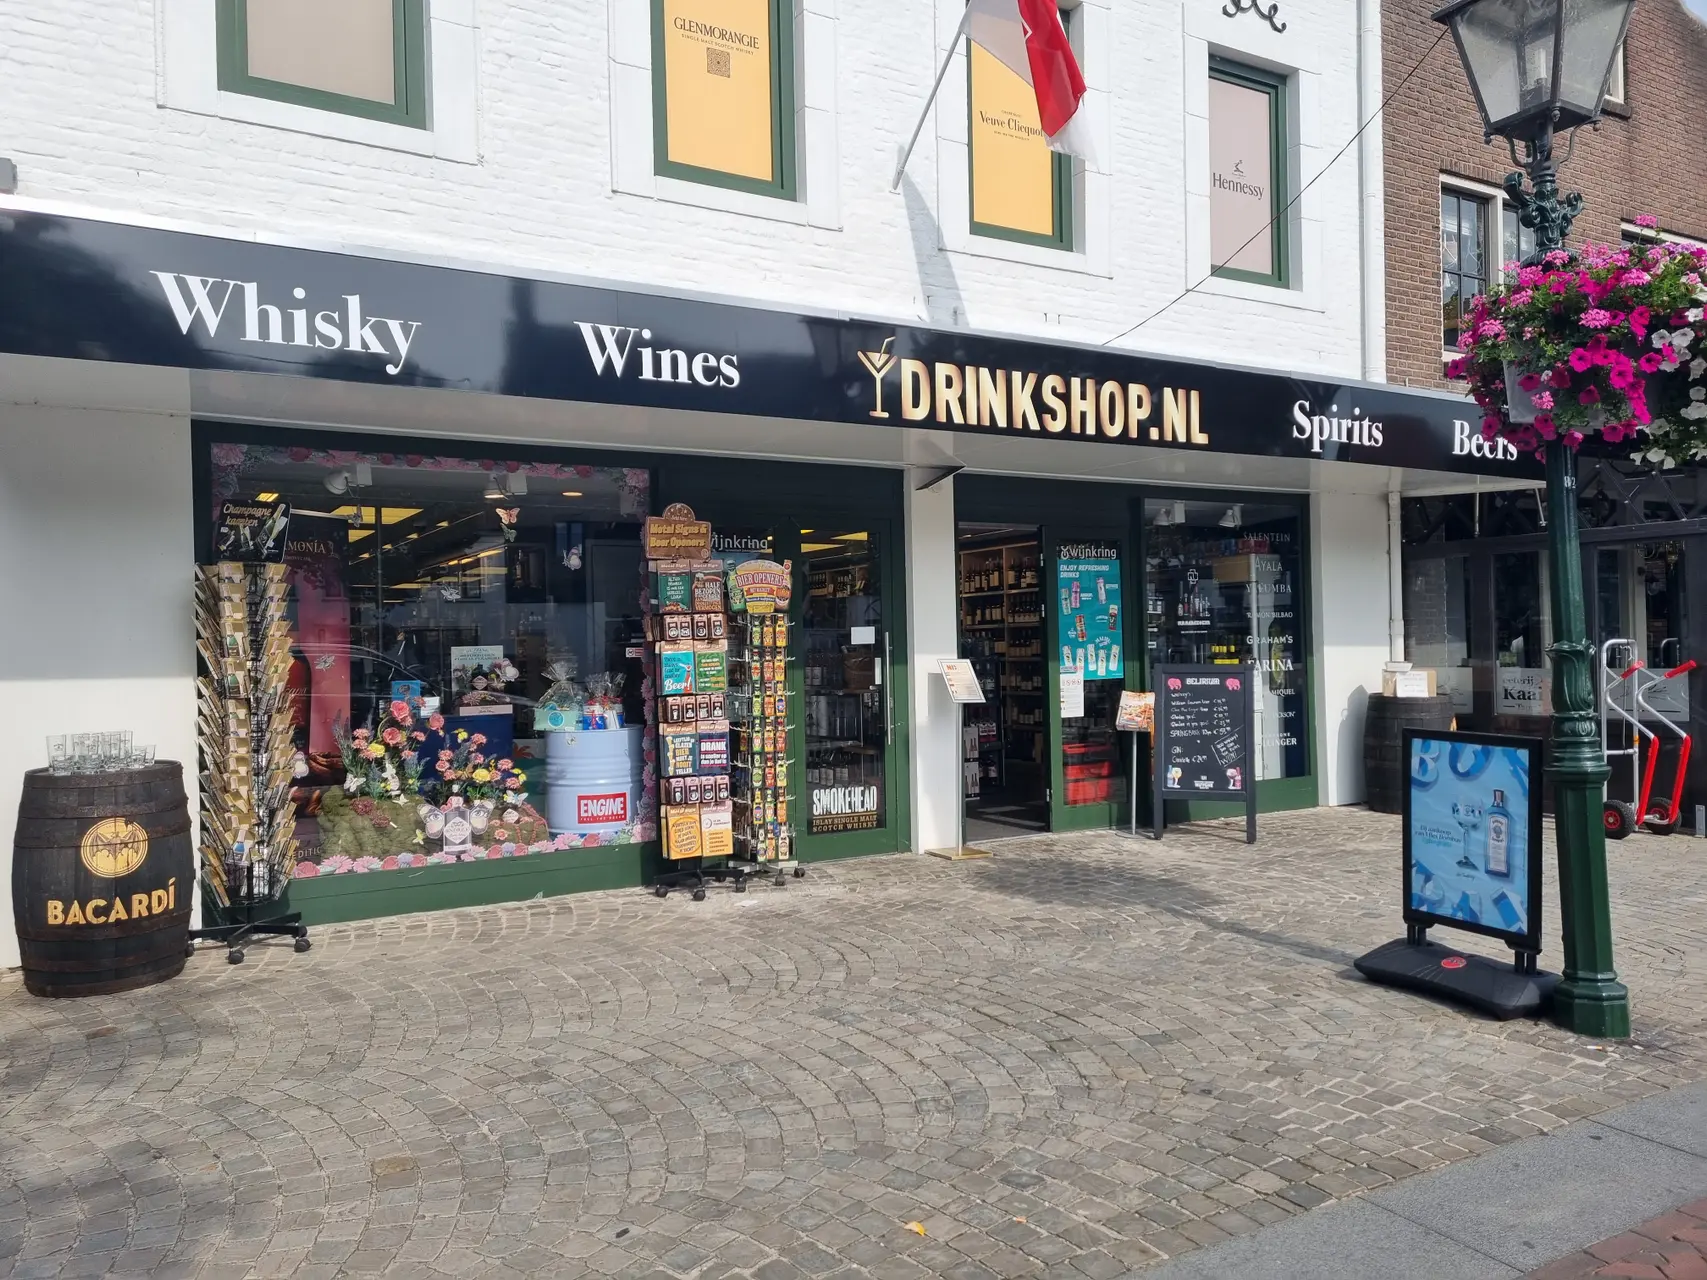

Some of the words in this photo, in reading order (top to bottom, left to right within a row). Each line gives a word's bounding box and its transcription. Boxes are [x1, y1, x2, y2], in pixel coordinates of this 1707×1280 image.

[674, 16, 760, 49] GLENMORANGIE
[715, 42, 734, 50] SCOTCH
[980, 110, 1006, 128] Veuve
[1213, 172, 1264, 200] Hennessy
[149, 270, 422, 375] Whisky
[573, 320, 740, 388] Wines
[901, 358, 1209, 444] DRINKSHOP.NL
[1293, 400, 1384, 452] Spirits
[224, 503, 272, 516] Champagne
[650, 524, 674, 534] Metal
[675, 524, 699, 535] Signs
[1243, 531, 1291, 542] SALENTEIN
[650, 537, 669, 547] Beer
[1069, 545, 1117, 559] wijnkring
[1255, 556, 1283, 572] AYALA
[737, 572, 753, 586] BIER
[754, 572, 784, 584] OPENERS
[1246, 634, 1293, 644] GRAHAM'S
[664, 677, 691, 691] Beer!
[700, 742, 726, 751] DRANK
[580, 797, 624, 817] ENGINE
[813, 786, 877, 815] SMOKEHEAD
[813, 824, 844, 832] SCOTCH
[47, 877, 176, 925] BACARDÍ
